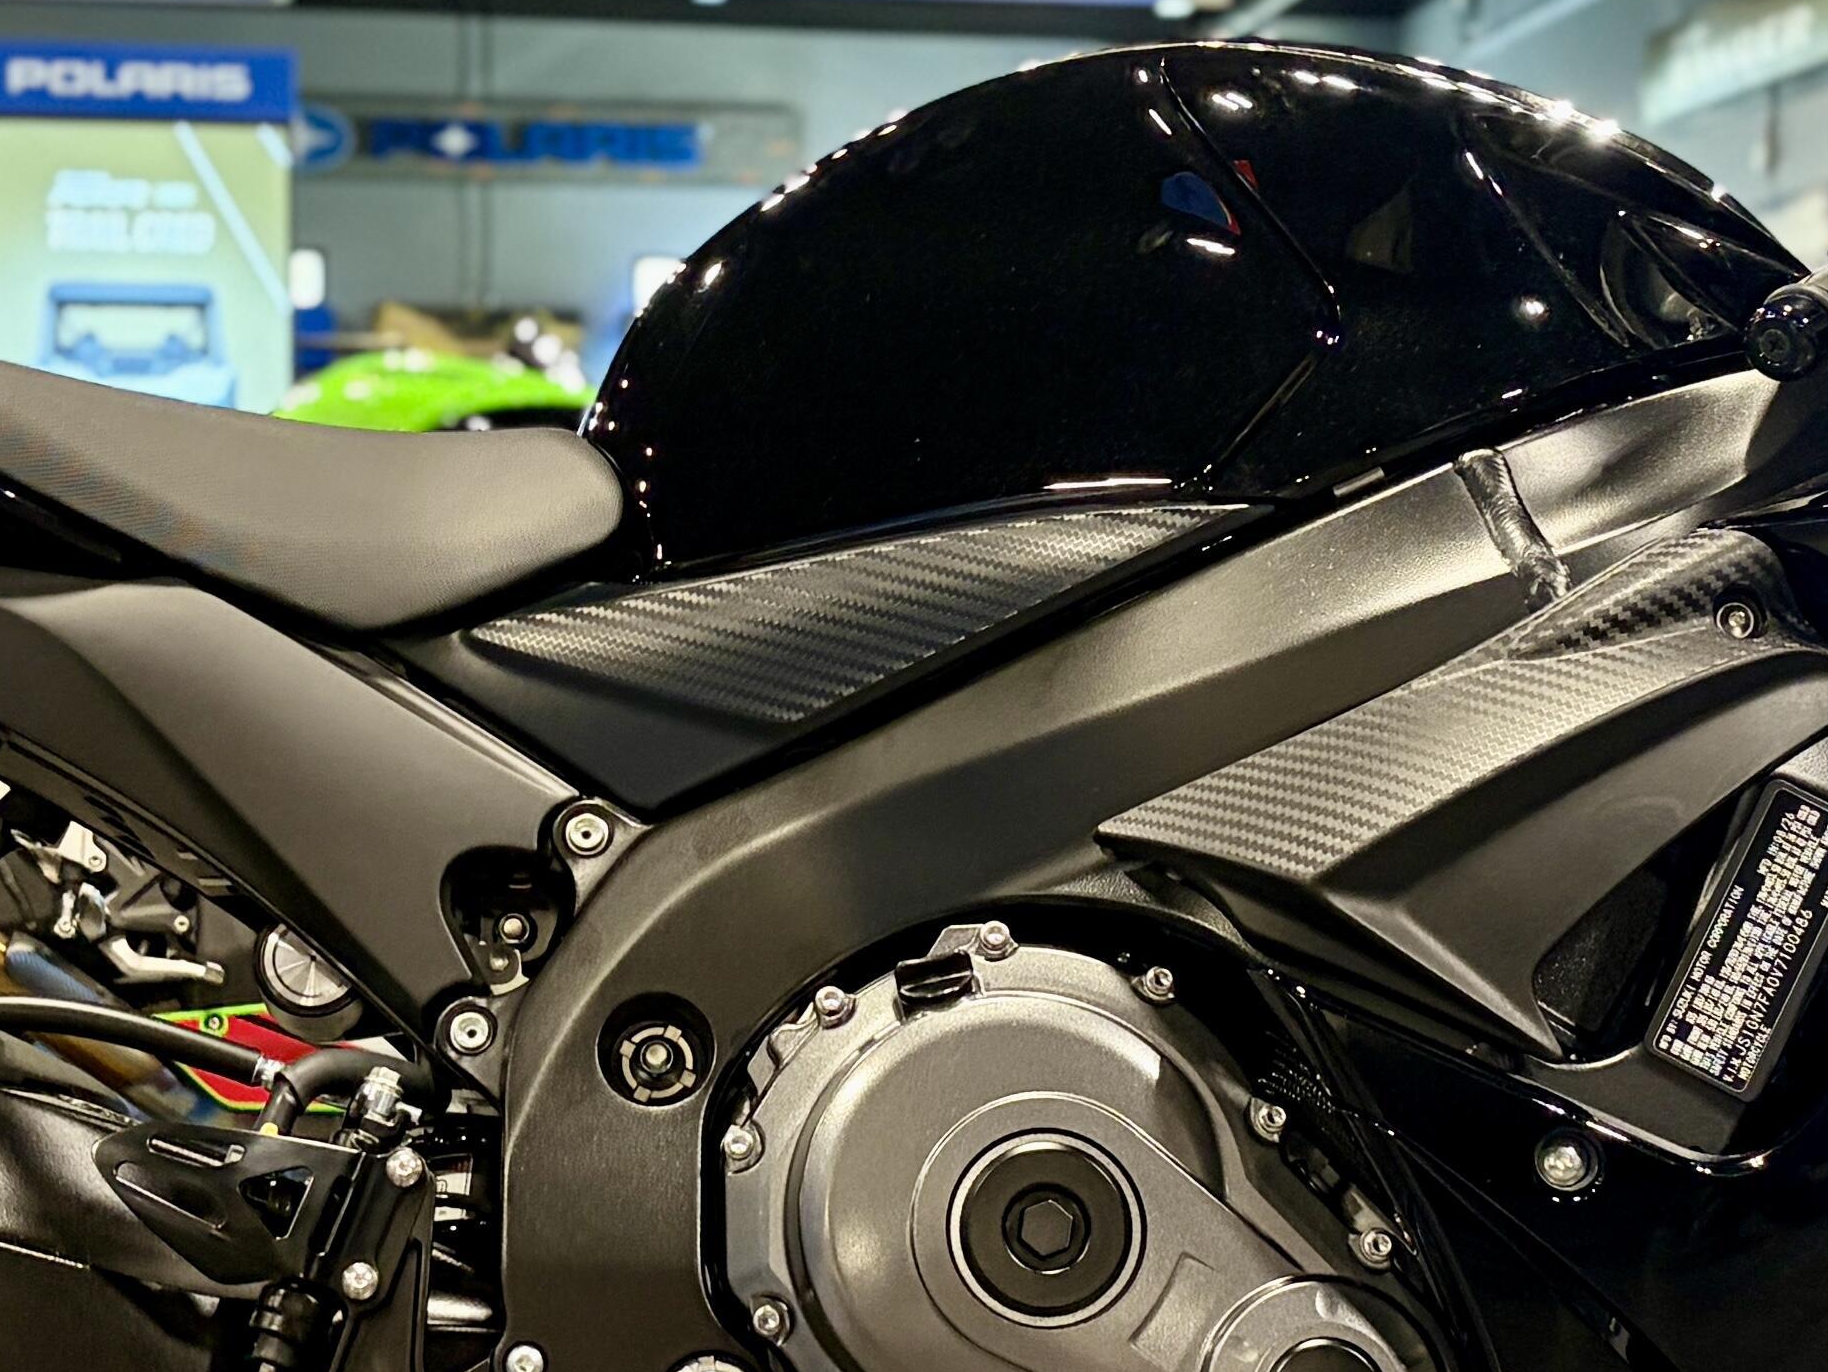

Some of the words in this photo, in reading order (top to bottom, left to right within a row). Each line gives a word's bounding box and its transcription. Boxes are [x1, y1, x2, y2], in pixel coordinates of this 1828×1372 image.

[5, 55, 252, 102] POLARIS
[1672, 985, 1696, 1019] SUZUKI
[1691, 951, 1712, 981] MOTOR
[1707, 885, 1744, 948] CORPORATION
[1738, 1024, 1773, 1082] MOTORCYCLE
